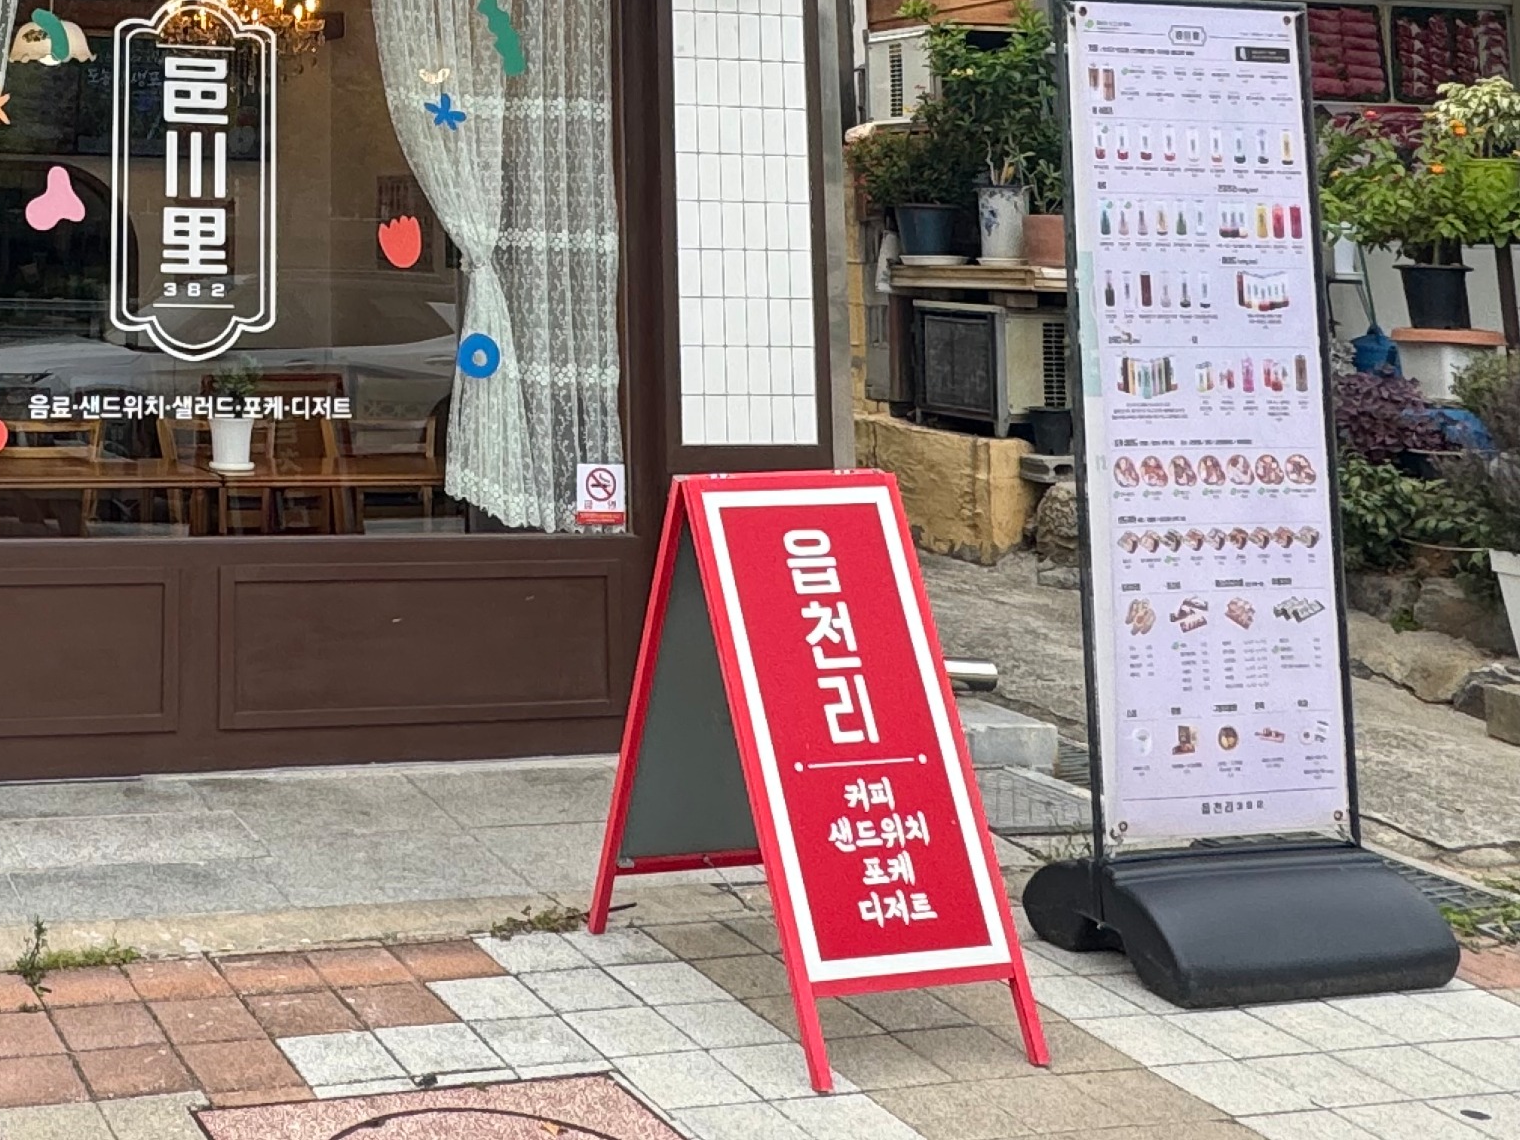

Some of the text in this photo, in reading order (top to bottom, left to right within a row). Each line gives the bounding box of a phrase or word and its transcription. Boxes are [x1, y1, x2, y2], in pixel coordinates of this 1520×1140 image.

[160, 56, 230, 275] 邑川里
[163, 282, 226, 297] 382
[782, 528, 880, 745] 읍천리
[844, 777, 897, 813] 커피
[828, 810, 932, 854] 샌드위치
[862, 851, 917, 888] 포케
[858, 890, 939, 929] 디저트
